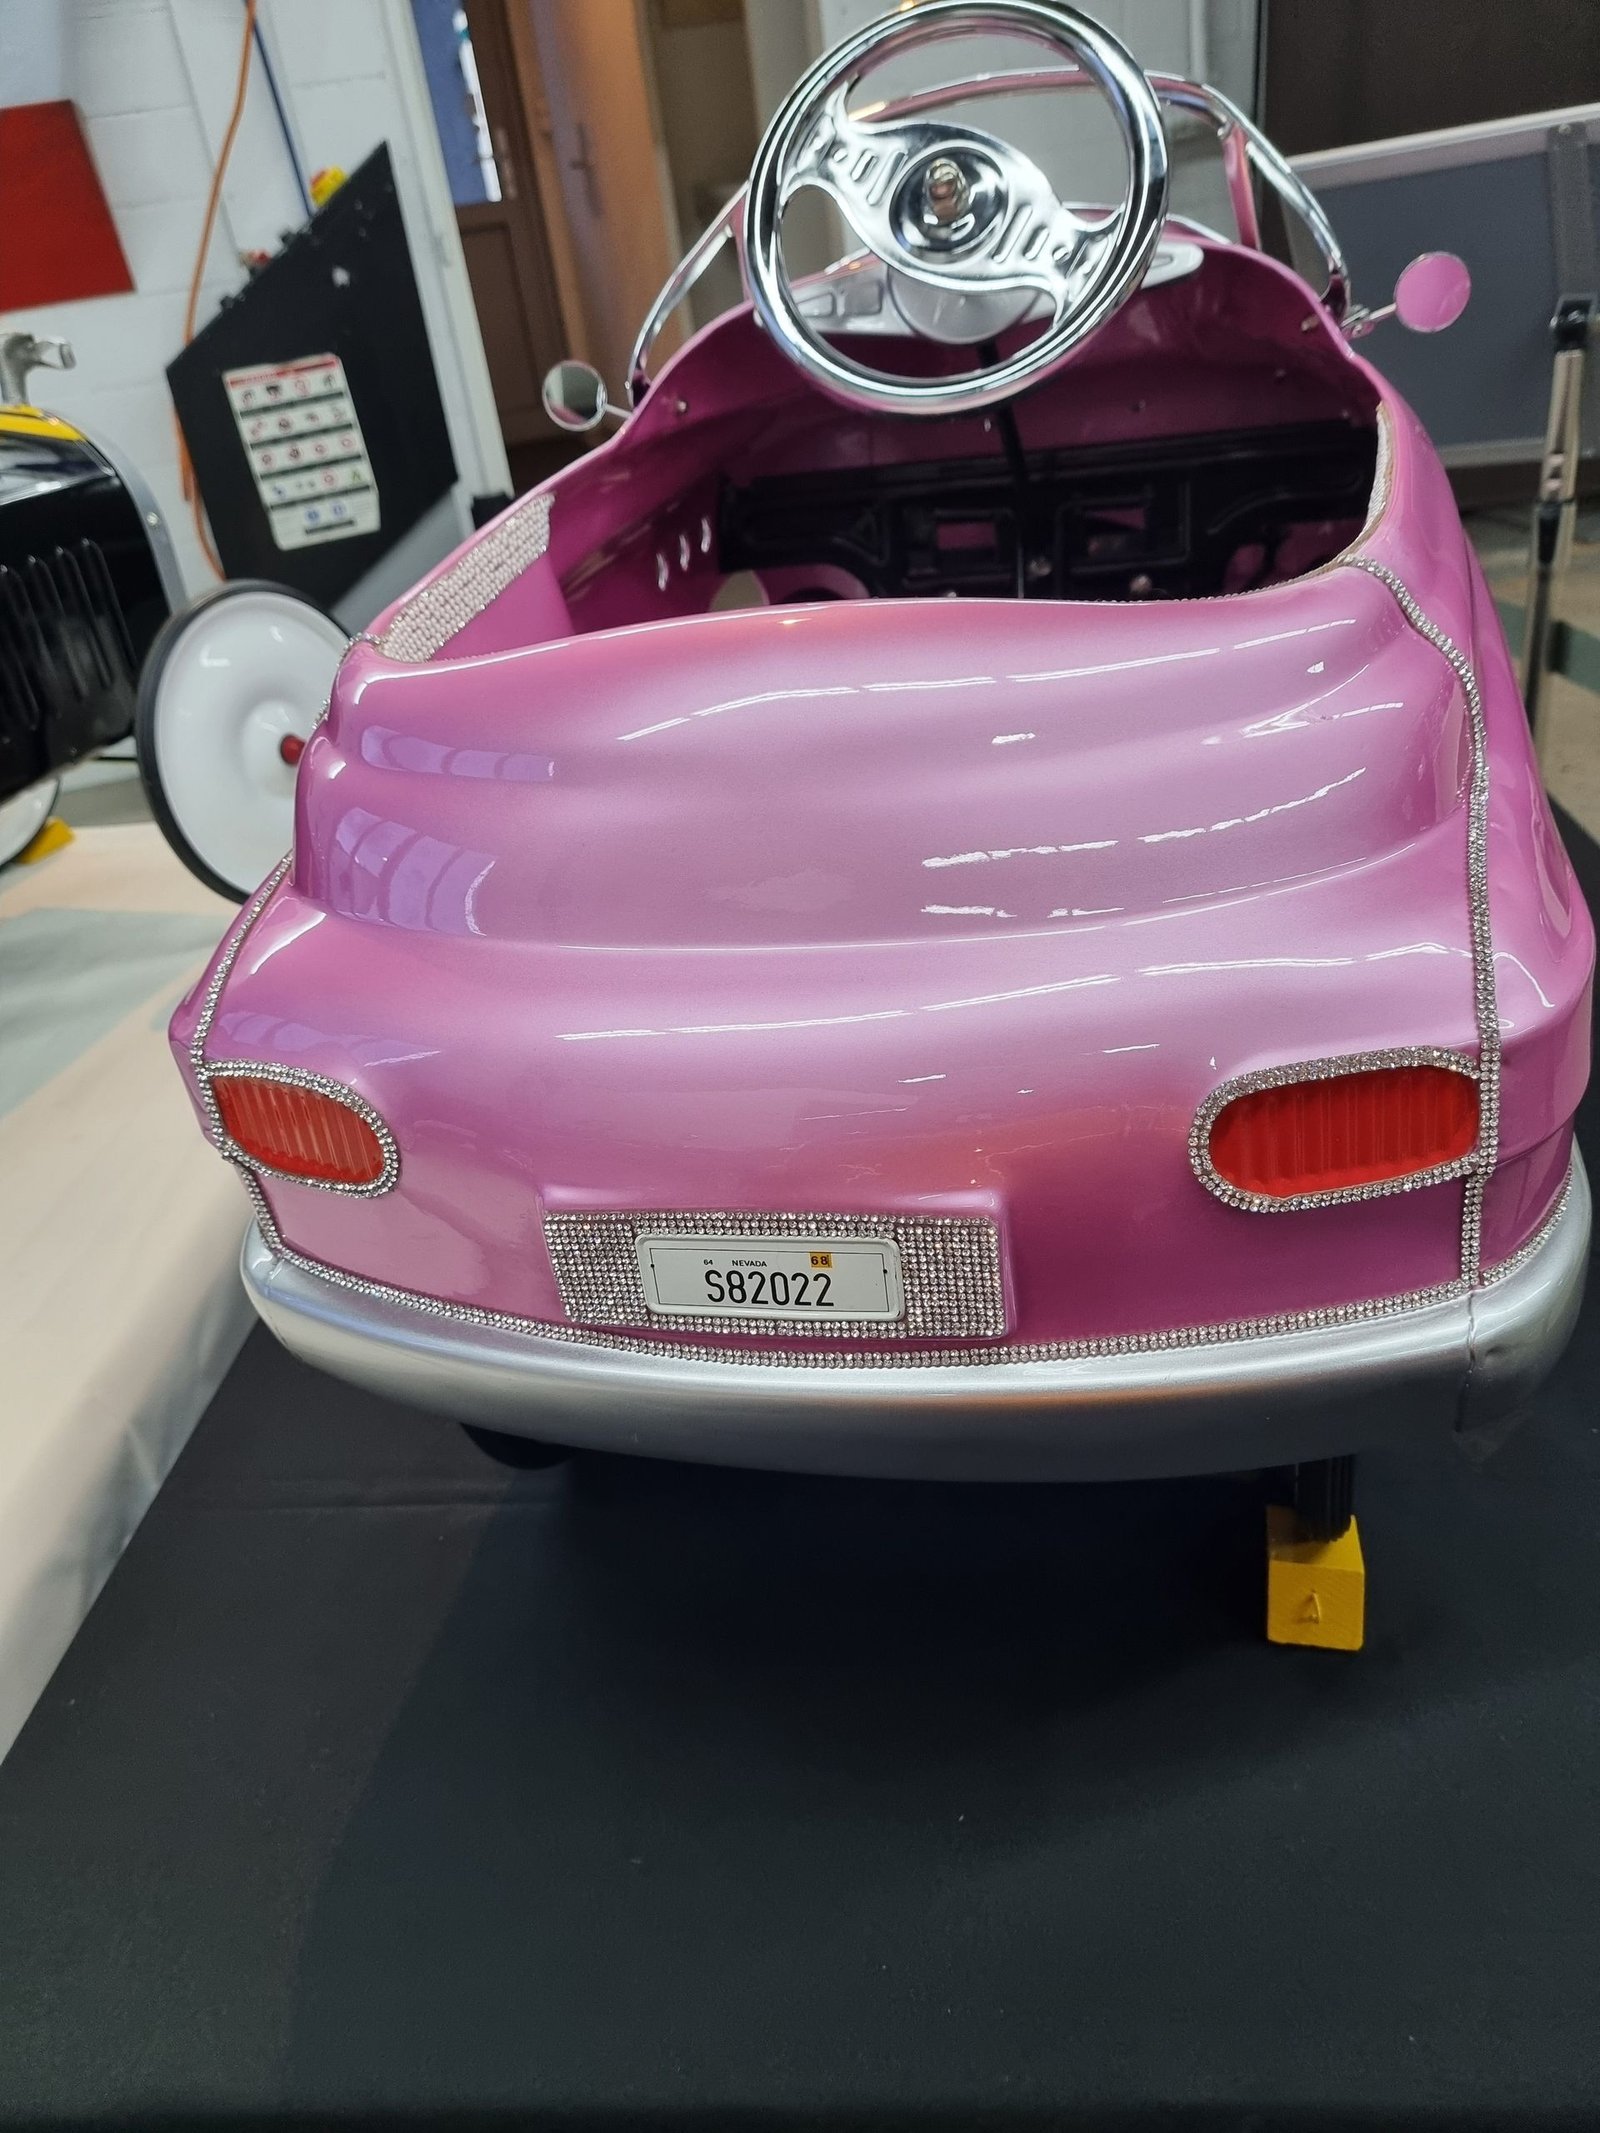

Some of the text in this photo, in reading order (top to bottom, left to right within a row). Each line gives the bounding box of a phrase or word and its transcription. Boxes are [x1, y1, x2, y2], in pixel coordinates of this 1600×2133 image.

[731, 1259, 768, 1268] NEVADA
[810, 1255, 829, 1266] 68
[704, 1269, 835, 1307] S82022
